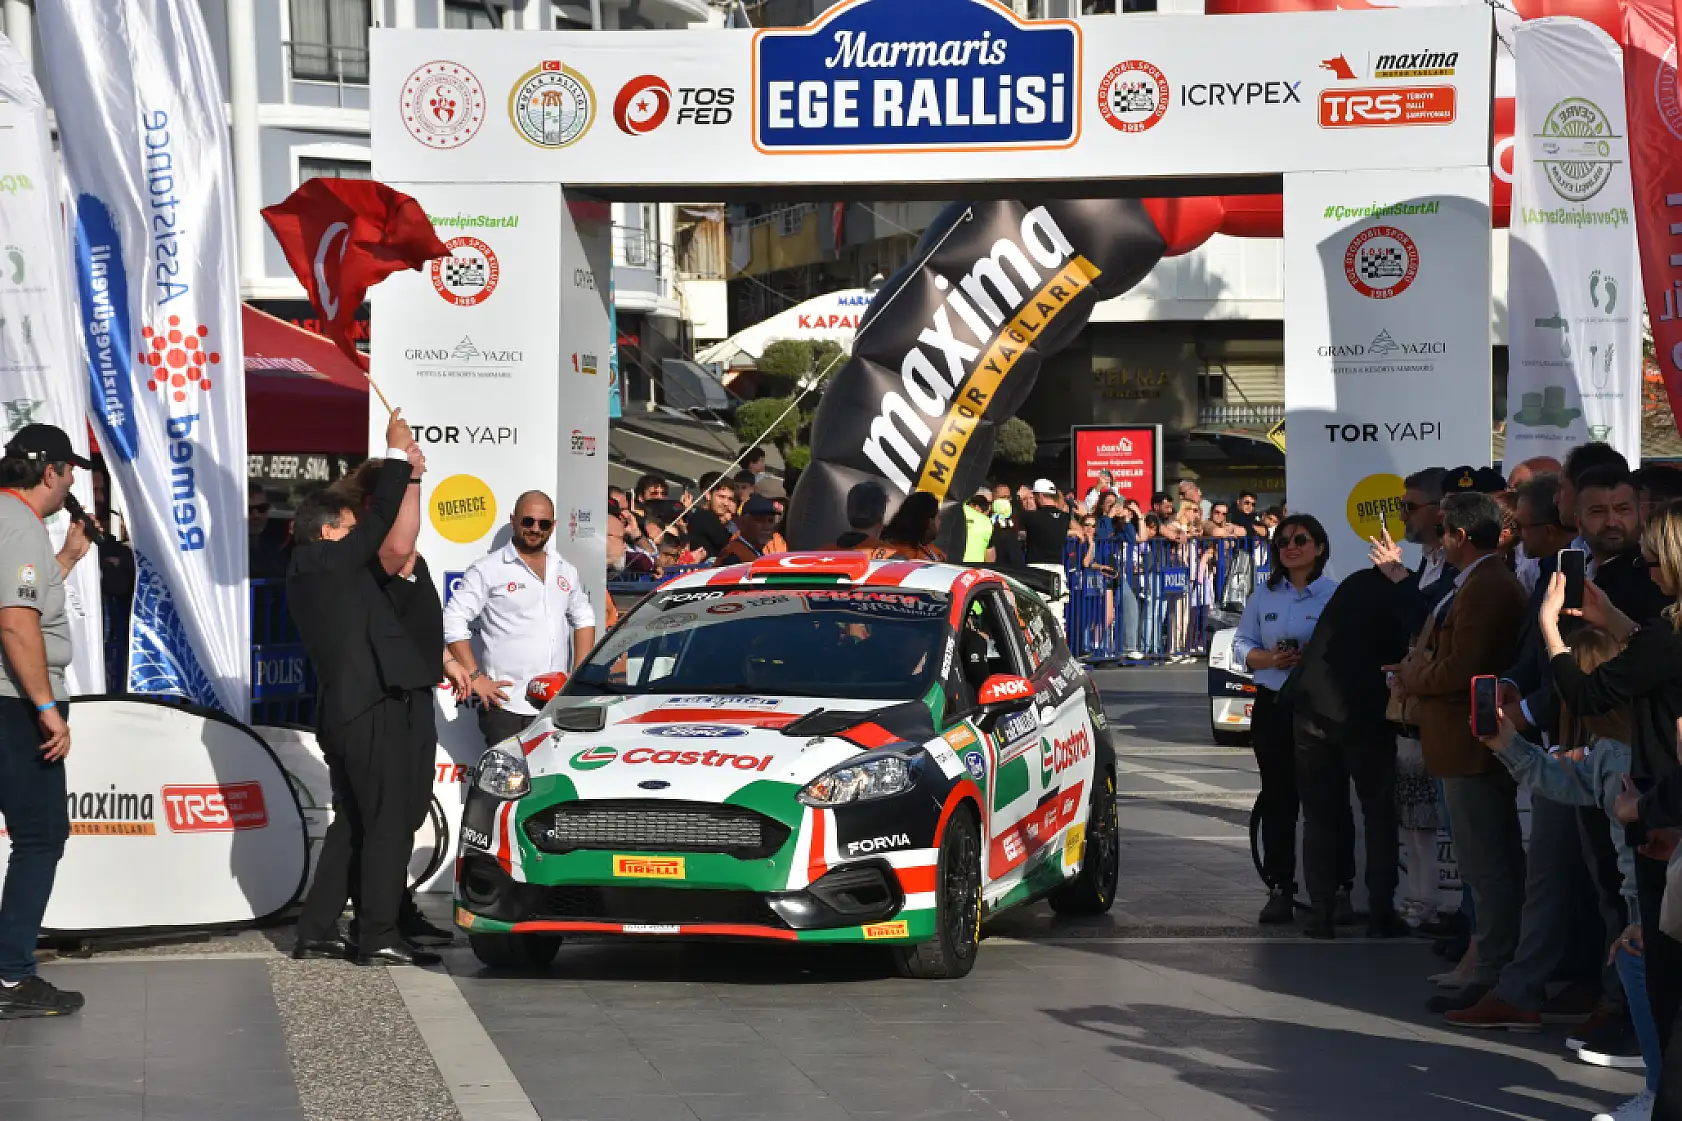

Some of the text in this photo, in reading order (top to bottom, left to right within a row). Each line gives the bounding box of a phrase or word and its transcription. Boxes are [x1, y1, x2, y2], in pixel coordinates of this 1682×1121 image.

[825, 30, 1007, 68] Marmaris
[1375, 49, 1459, 69] maxima
[677, 88, 735, 105] TOS
[1181, 81, 1301, 106] ICRYPEX
[769, 80, 860, 128] EGE
[1324, 93, 1403, 122] TRS
[676, 107, 732, 125] FED
[838, 295, 875, 307] MARM
[799, 314, 862, 329] KAPAL
[405, 349, 524, 362] GRAND YAZICI
[862, 205, 1075, 496] maxima
[1317, 342, 1447, 356] GRAND YAZICI
[929, 275, 1080, 484] MOTOR YAĞLARI
[411, 426, 518, 444] TOR YAPI
[1325, 422, 1441, 443] TOR YAPI
[1357, 496, 1402, 517] 9DEREC
[992, 680, 1028, 697] NGK
[1053, 722, 1091, 774] Castrol
[622, 748, 774, 771] Castrol
[166, 793, 229, 825] TRS
[70, 824, 100, 835] OTOR
[847, 833, 911, 856] FORVIA
[618, 858, 679, 876] PIRELLI
[866, 924, 906, 938] PIRELLI
